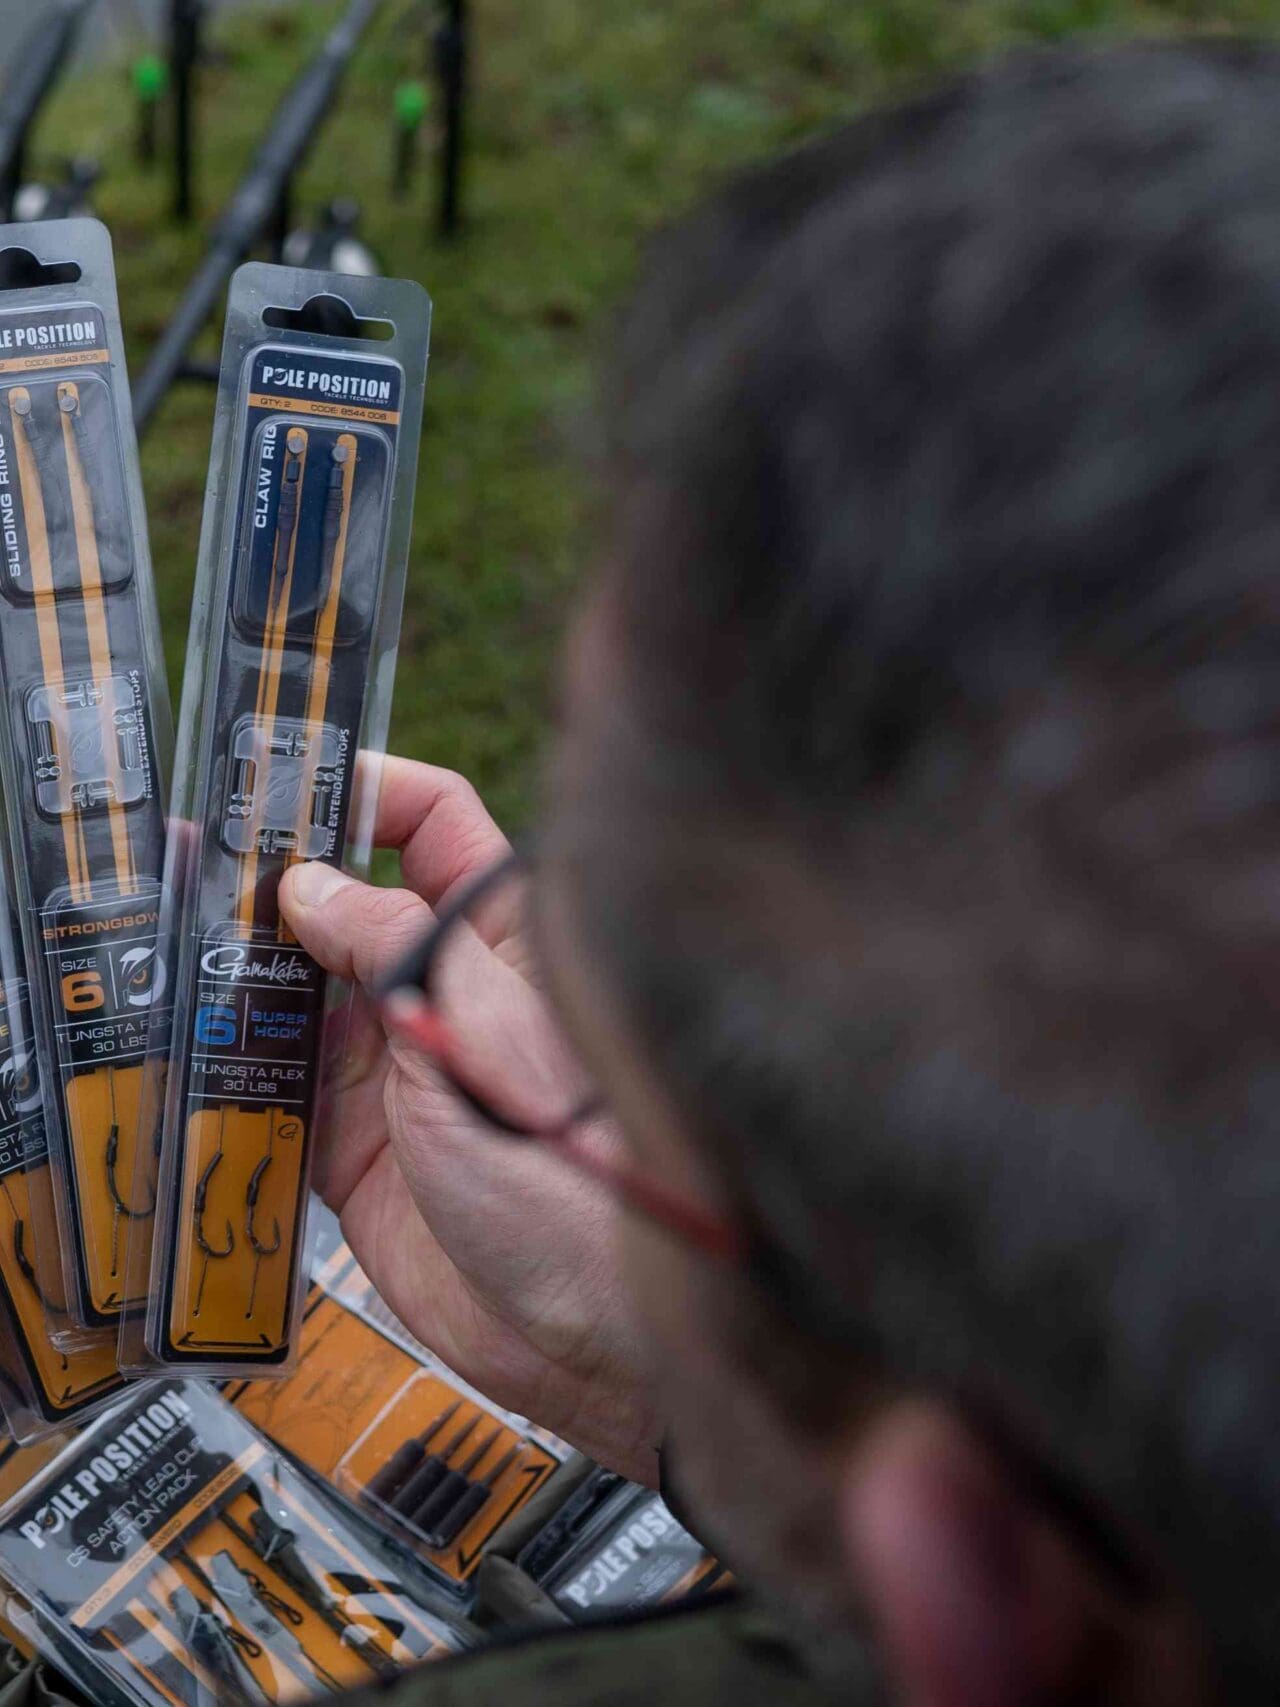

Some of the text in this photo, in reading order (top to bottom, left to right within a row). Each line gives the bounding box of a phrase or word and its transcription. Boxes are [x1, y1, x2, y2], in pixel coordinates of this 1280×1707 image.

[15, 321, 96, 347] POSITION
[58, 340, 96, 349] TECHNOLOGY
[262, 366, 391, 399] POLE POSITION
[259, 396, 282, 407] QTY:
[283, 399, 292, 408] 2
[309, 402, 338, 414] CODE:
[324, 392, 389, 405] TACKLE TECHNOLOGY
[255, 425, 277, 528] CLAW RIG
[0, 493, 20, 577] SLIDING
[129, 669, 143, 706] STOPS
[323, 728, 350, 857] FREE EXTENDER STOPS
[61, 957, 97, 972] SIZE
[201, 946, 311, 985] Gamakatsu
[61, 971, 105, 1012] 6
[200, 992, 236, 1005] SIZE
[194, 1005, 237, 1045] 6
[250, 1011, 308, 1025] SUPER
[56, 1022, 136, 1044] TUNGSTA
[92, 1035, 149, 1054] 30 LBS
[254, 1026, 302, 1040] HOOK
[191, 1062, 305, 1080] TUNGSTA FLEX
[223, 1079, 277, 1094] 30 LBS
[15, 1137, 45, 1158] LBS
[20, 1483, 90, 1549] POLE
[75, 1389, 192, 1497] POSITION
[67, 1545, 90, 1567] CS
[87, 1495, 140, 1548] SAFETY
[138, 1462, 177, 1499] LEAD
[109, 1504, 162, 1554] ACTION
[156, 1468, 199, 1507] PACK
[566, 1549, 628, 1608] POLE
